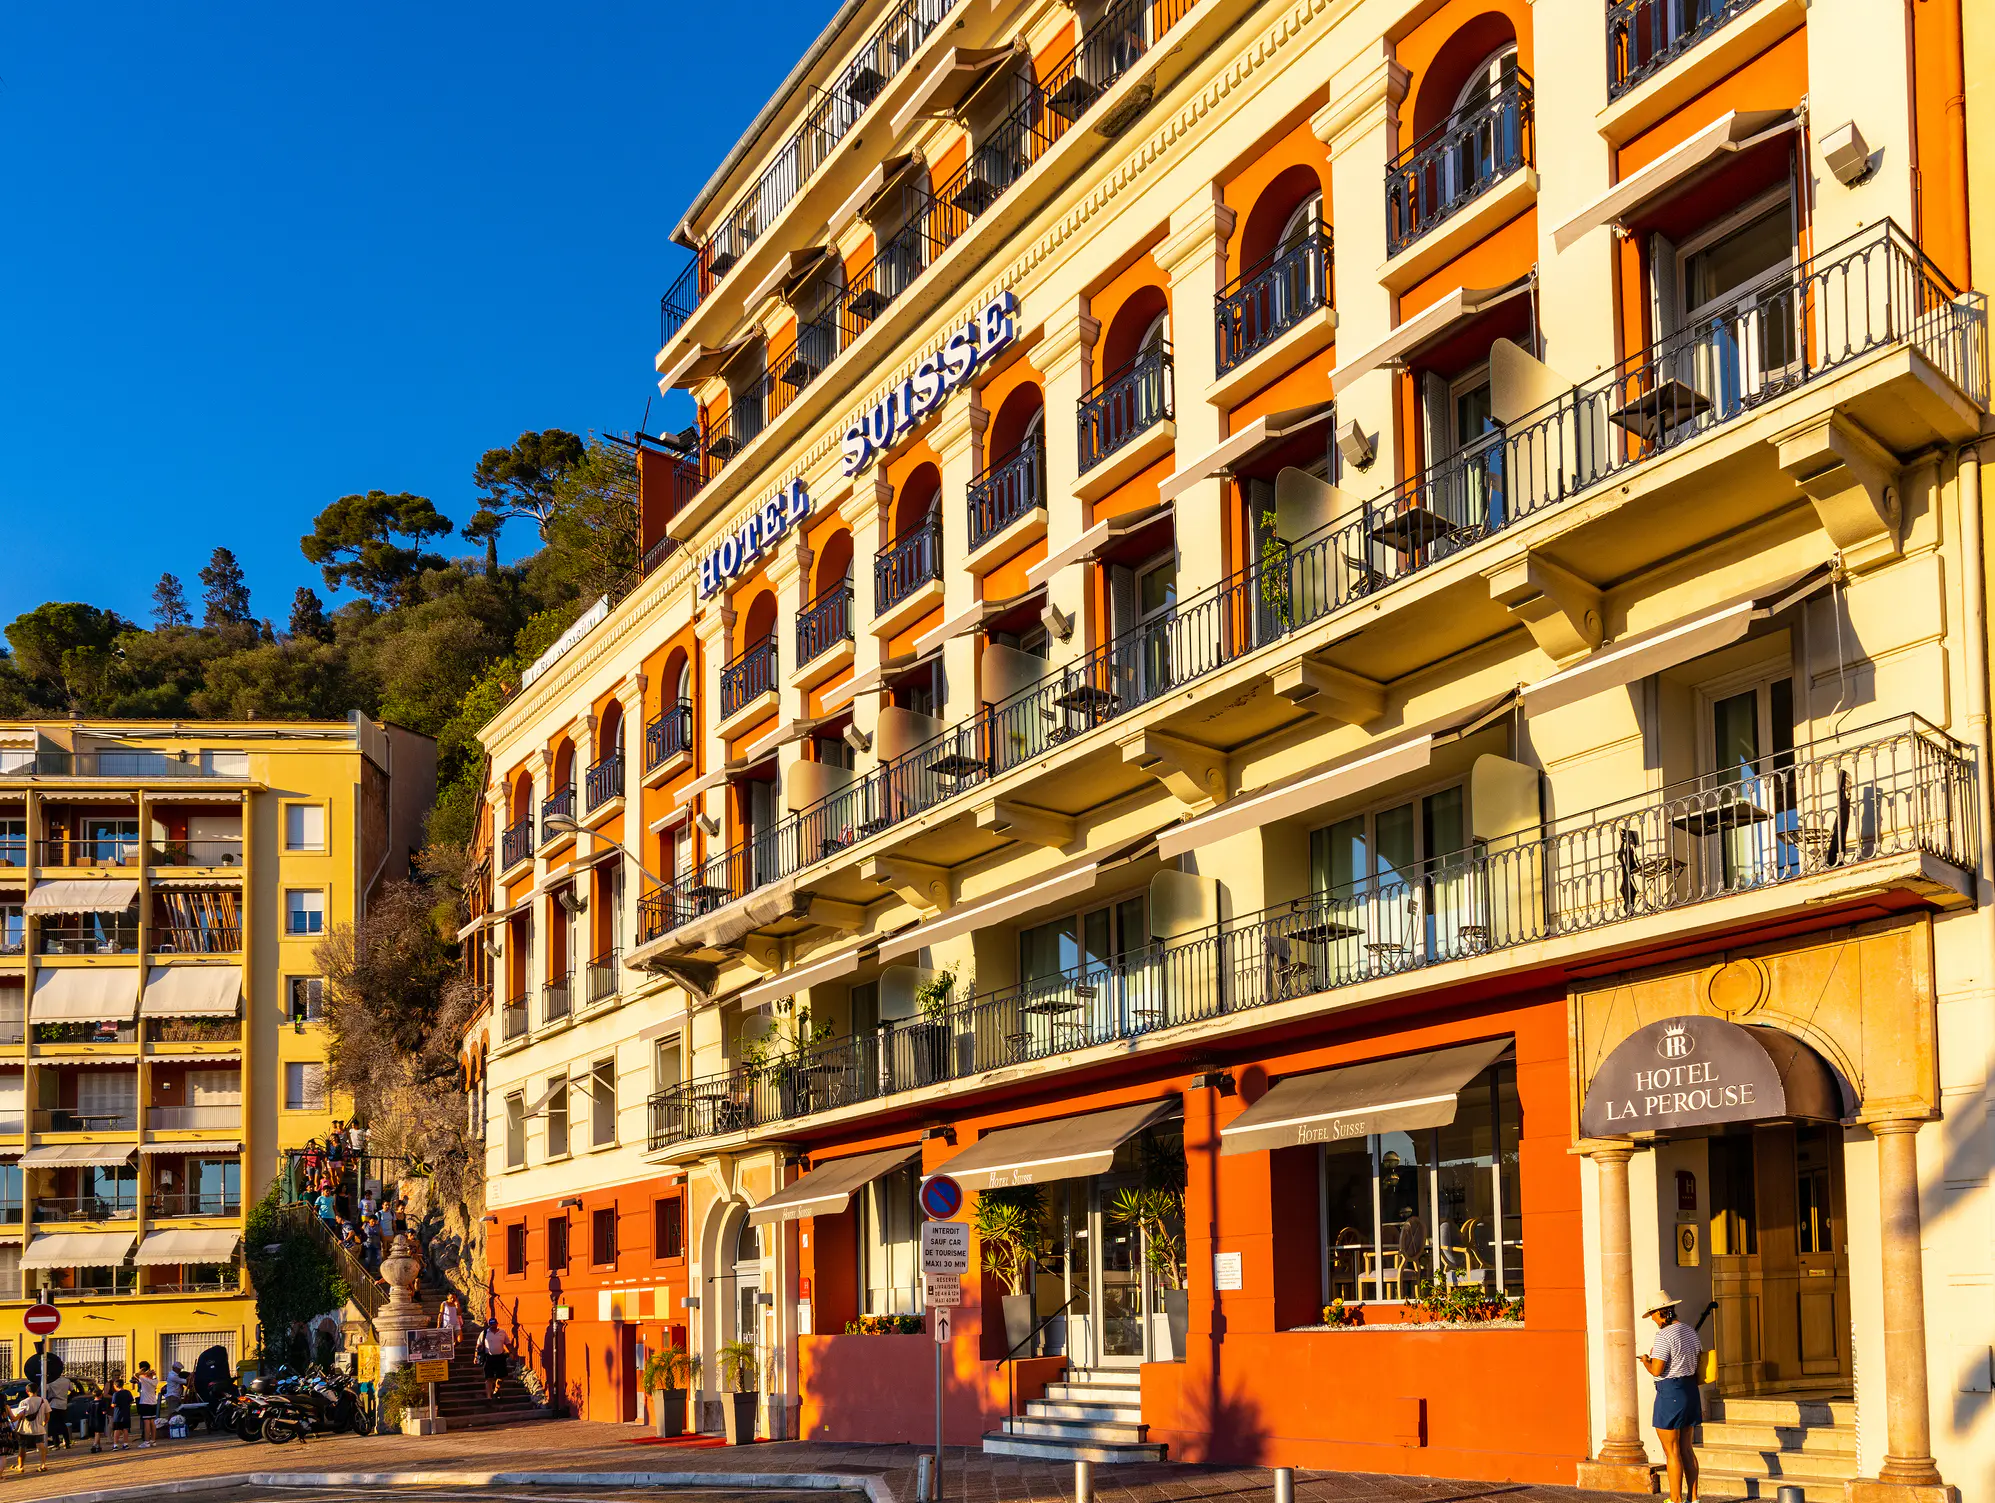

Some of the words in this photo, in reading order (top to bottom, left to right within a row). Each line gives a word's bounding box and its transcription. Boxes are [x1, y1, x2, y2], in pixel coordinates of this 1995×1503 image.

[698, 477, 810, 600] HOTEL
[841, 290, 1015, 477] SUISSE
[1636, 1061, 1720, 1093] HOTEL
[1605, 1099, 1638, 1121] LA
[1644, 1083, 1757, 1116] PEROUSE
[936, 1249, 966, 1257] TOURISME
